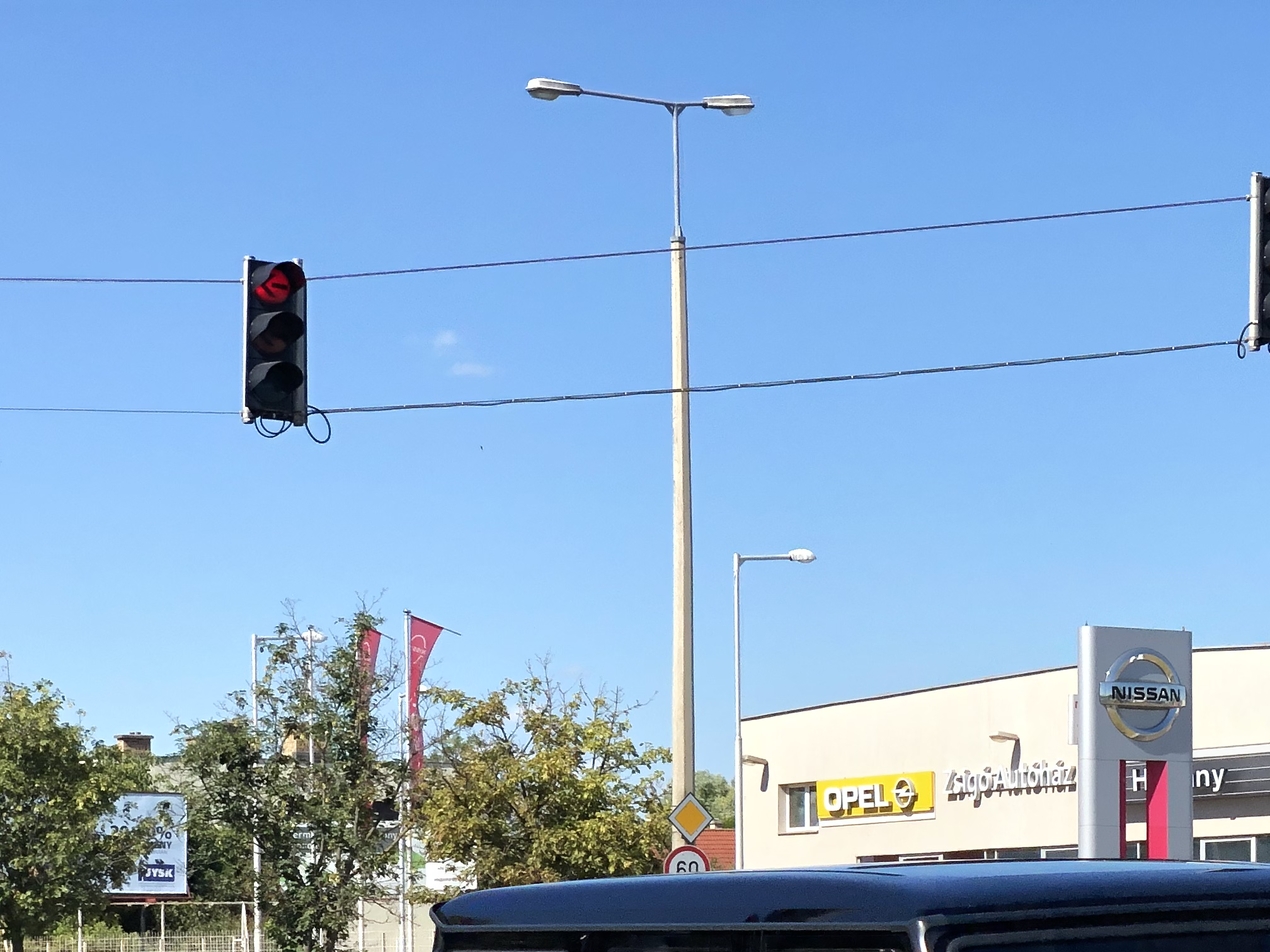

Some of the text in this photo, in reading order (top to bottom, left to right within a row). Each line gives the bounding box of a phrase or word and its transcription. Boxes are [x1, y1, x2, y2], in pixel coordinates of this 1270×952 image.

[1111, 686, 1181, 702] NISSAN
[823, 784, 890, 812] OPEL
[145, 868, 173, 878] JYSK
[677, 861, 698, 873] 60
